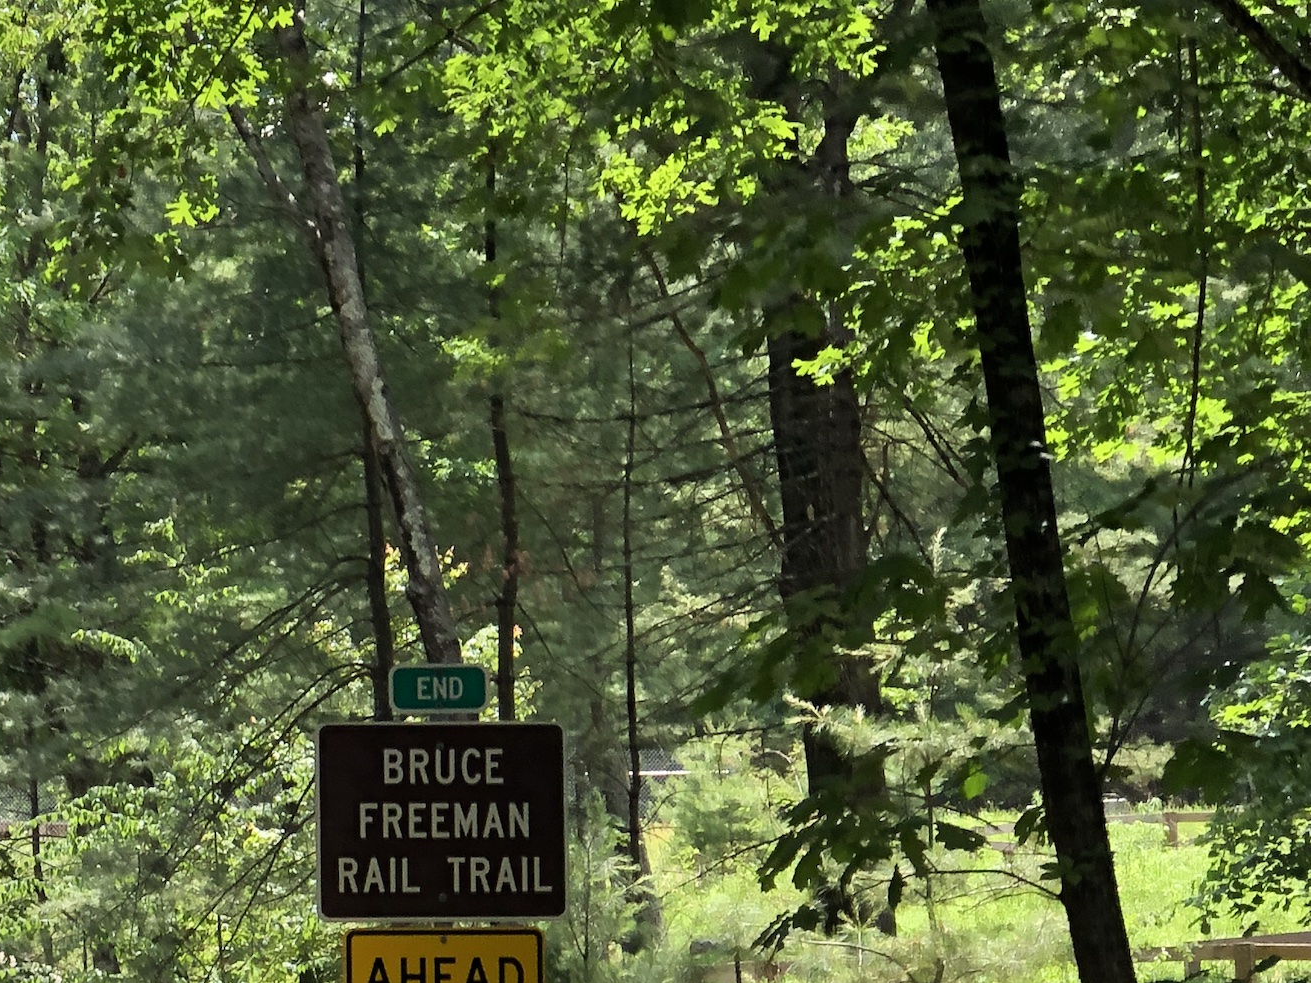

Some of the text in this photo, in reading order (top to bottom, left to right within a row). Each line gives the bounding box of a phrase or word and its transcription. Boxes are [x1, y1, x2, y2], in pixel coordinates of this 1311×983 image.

[416, 676, 464, 700] END
[383, 748, 505, 785] BRUCE
[359, 802, 530, 839] FREEMAN
[338, 857, 553, 893] RAIL TRAIL
